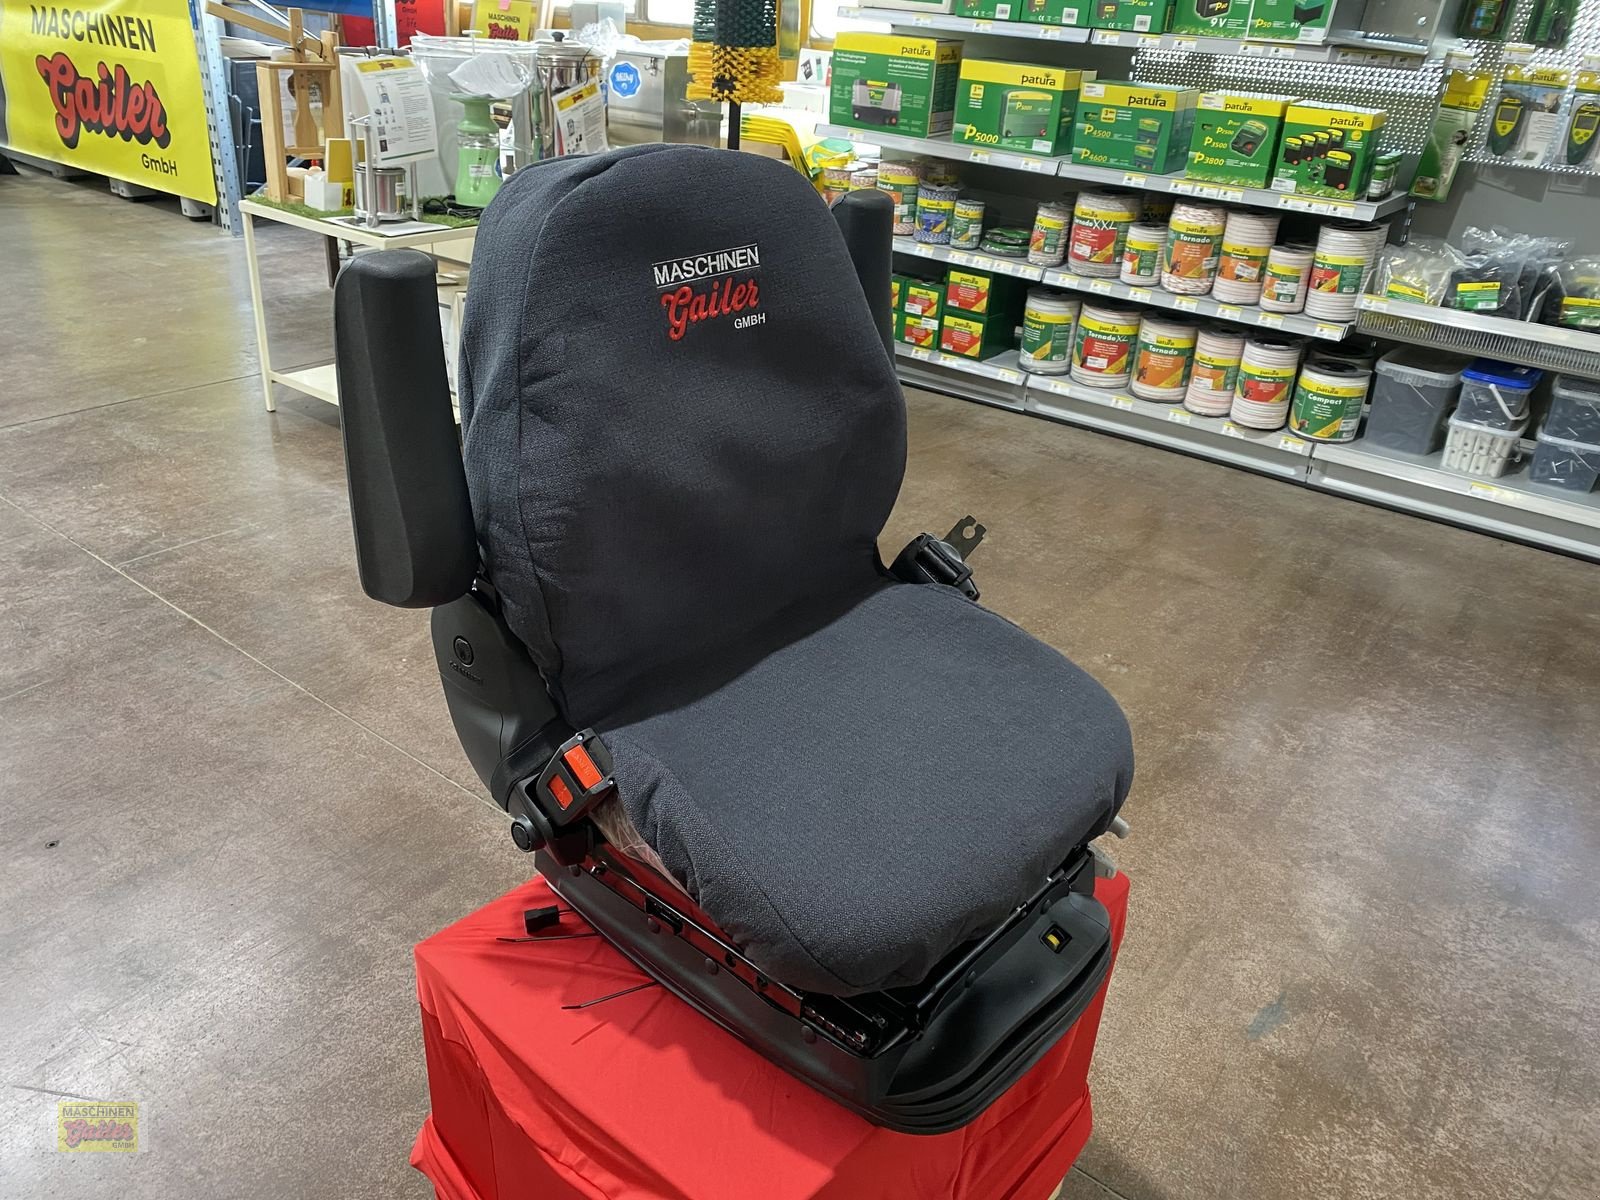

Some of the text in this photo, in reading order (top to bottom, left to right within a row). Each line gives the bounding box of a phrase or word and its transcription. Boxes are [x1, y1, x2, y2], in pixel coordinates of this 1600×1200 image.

[488, 12, 520, 24] MASCHINEN
[30, 5, 156, 52] MASCHINEN
[901, 45, 931, 57] patura
[1021, 74, 1056, 86] patura
[35, 51, 171, 149] Gailer
[1128, 95, 1167, 107] patura
[1225, 103, 1253, 112] patura
[1330, 116, 1364, 127] patura
[964, 123, 999, 144] P5000
[1084, 124, 1111, 137] P4500
[1204, 136, 1228, 149] P3500
[1081, 149, 1108, 162] P4600
[1193, 152, 1225, 166] P3800
[141, 153, 178, 176] GmbH
[1092, 218, 1117, 230] XXL
[1180, 234, 1211, 244] Tornado
[653, 246, 760, 285] MASCHINEN
[660, 277, 759, 341] Gailer
[734, 312, 766, 329] GMBH
[1088, 331, 1116, 341] Tornado
[1149, 345, 1178, 355] Tornado
[1308, 393, 1342, 405] Compact
